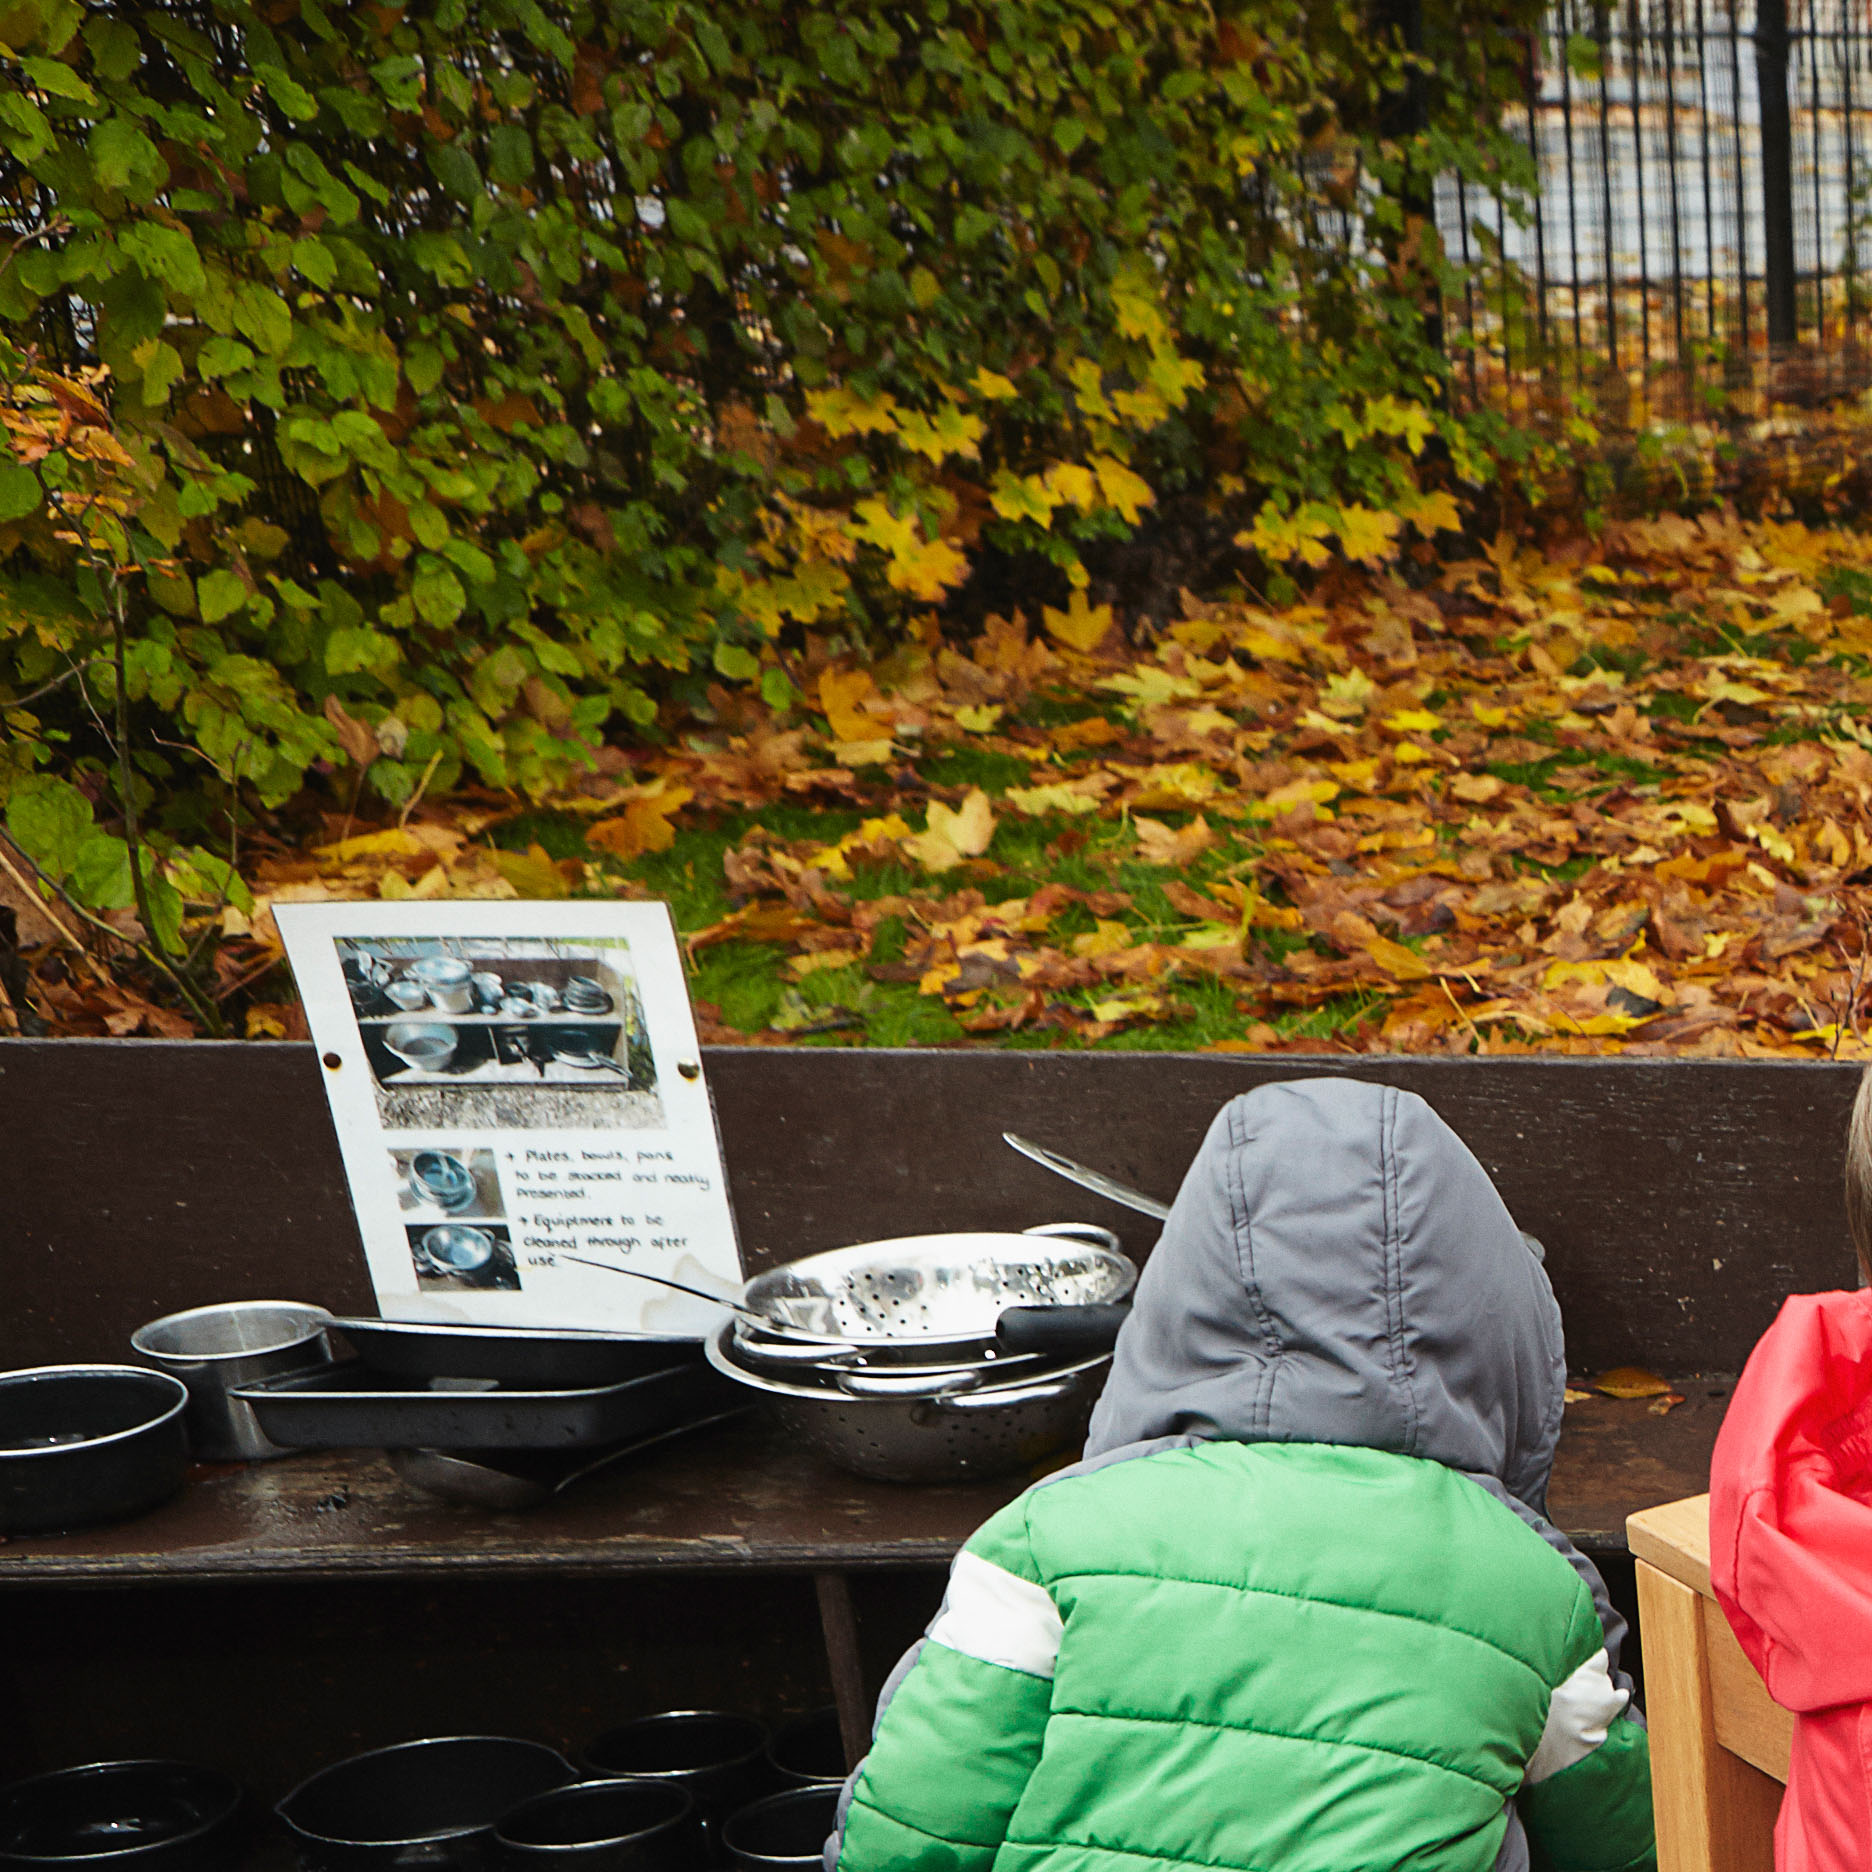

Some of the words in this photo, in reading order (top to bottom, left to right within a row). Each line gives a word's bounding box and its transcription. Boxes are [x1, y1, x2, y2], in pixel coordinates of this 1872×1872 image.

[515, 1170, 529, 1181] to
[538, 1170, 557, 1181] be
[633, 1170, 658, 1183] and
[665, 1172, 710, 1191] neatly
[621, 1215, 635, 1226] to
[645, 1214, 663, 1226] be
[588, 1237, 641, 1254] through
[651, 1237, 688, 1251] after
